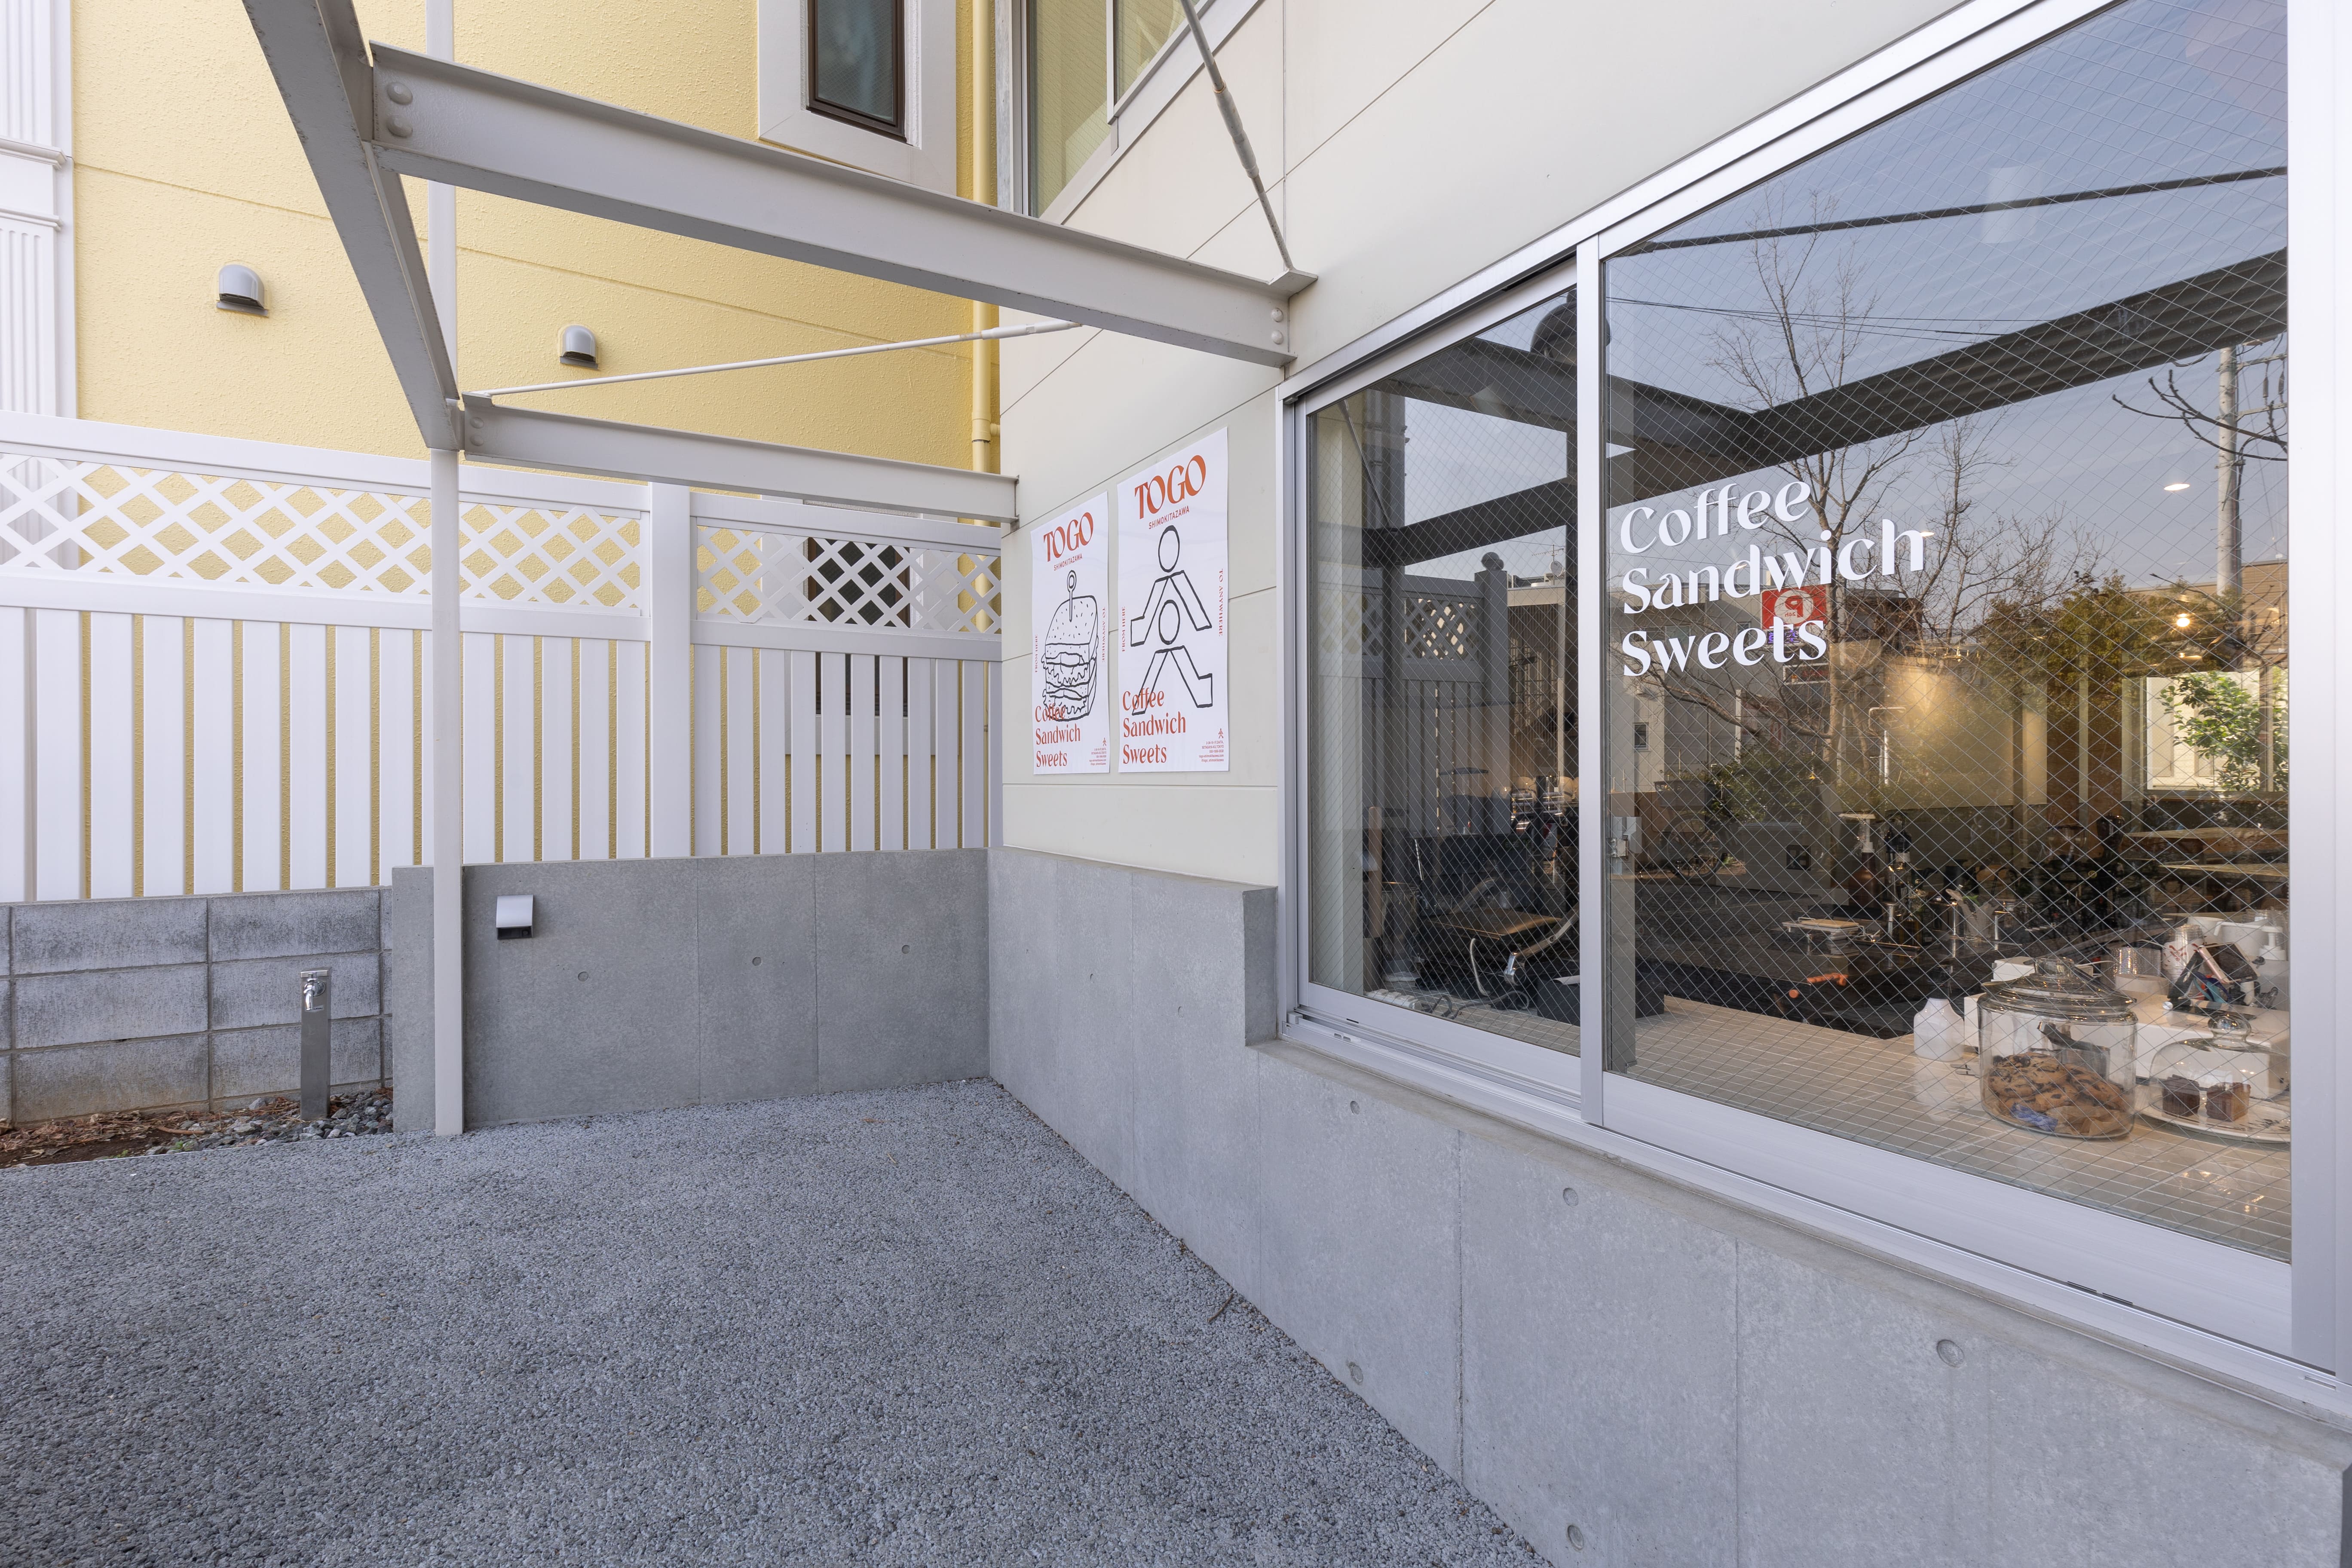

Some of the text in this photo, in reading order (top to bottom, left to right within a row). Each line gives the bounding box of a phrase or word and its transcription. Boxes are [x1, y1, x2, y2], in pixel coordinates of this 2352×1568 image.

[1134, 455, 1206, 519] TOGO
[1149, 505, 1189, 529] SHIMOKITAZAWA
[1621, 481, 1810, 553] Coffee
[1043, 512, 1093, 562] TOGO
[1054, 553, 1082, 571] SHIMOKITAZAWA
[1622, 519, 1924, 614] Sandwich
[1219, 568, 1223, 582] TO
[1102, 607, 1106, 618] TO
[1622, 616, 1827, 676] Sweets
[1122, 688, 1165, 710] Coffee
[1035, 703, 1066, 722] Coffee
[1036, 723, 1081, 745] Sandwich
[1123, 711, 1186, 738] Sandwich
[1036, 751, 1067, 767] Sweets
[1123, 744, 1167, 764] Sweets
